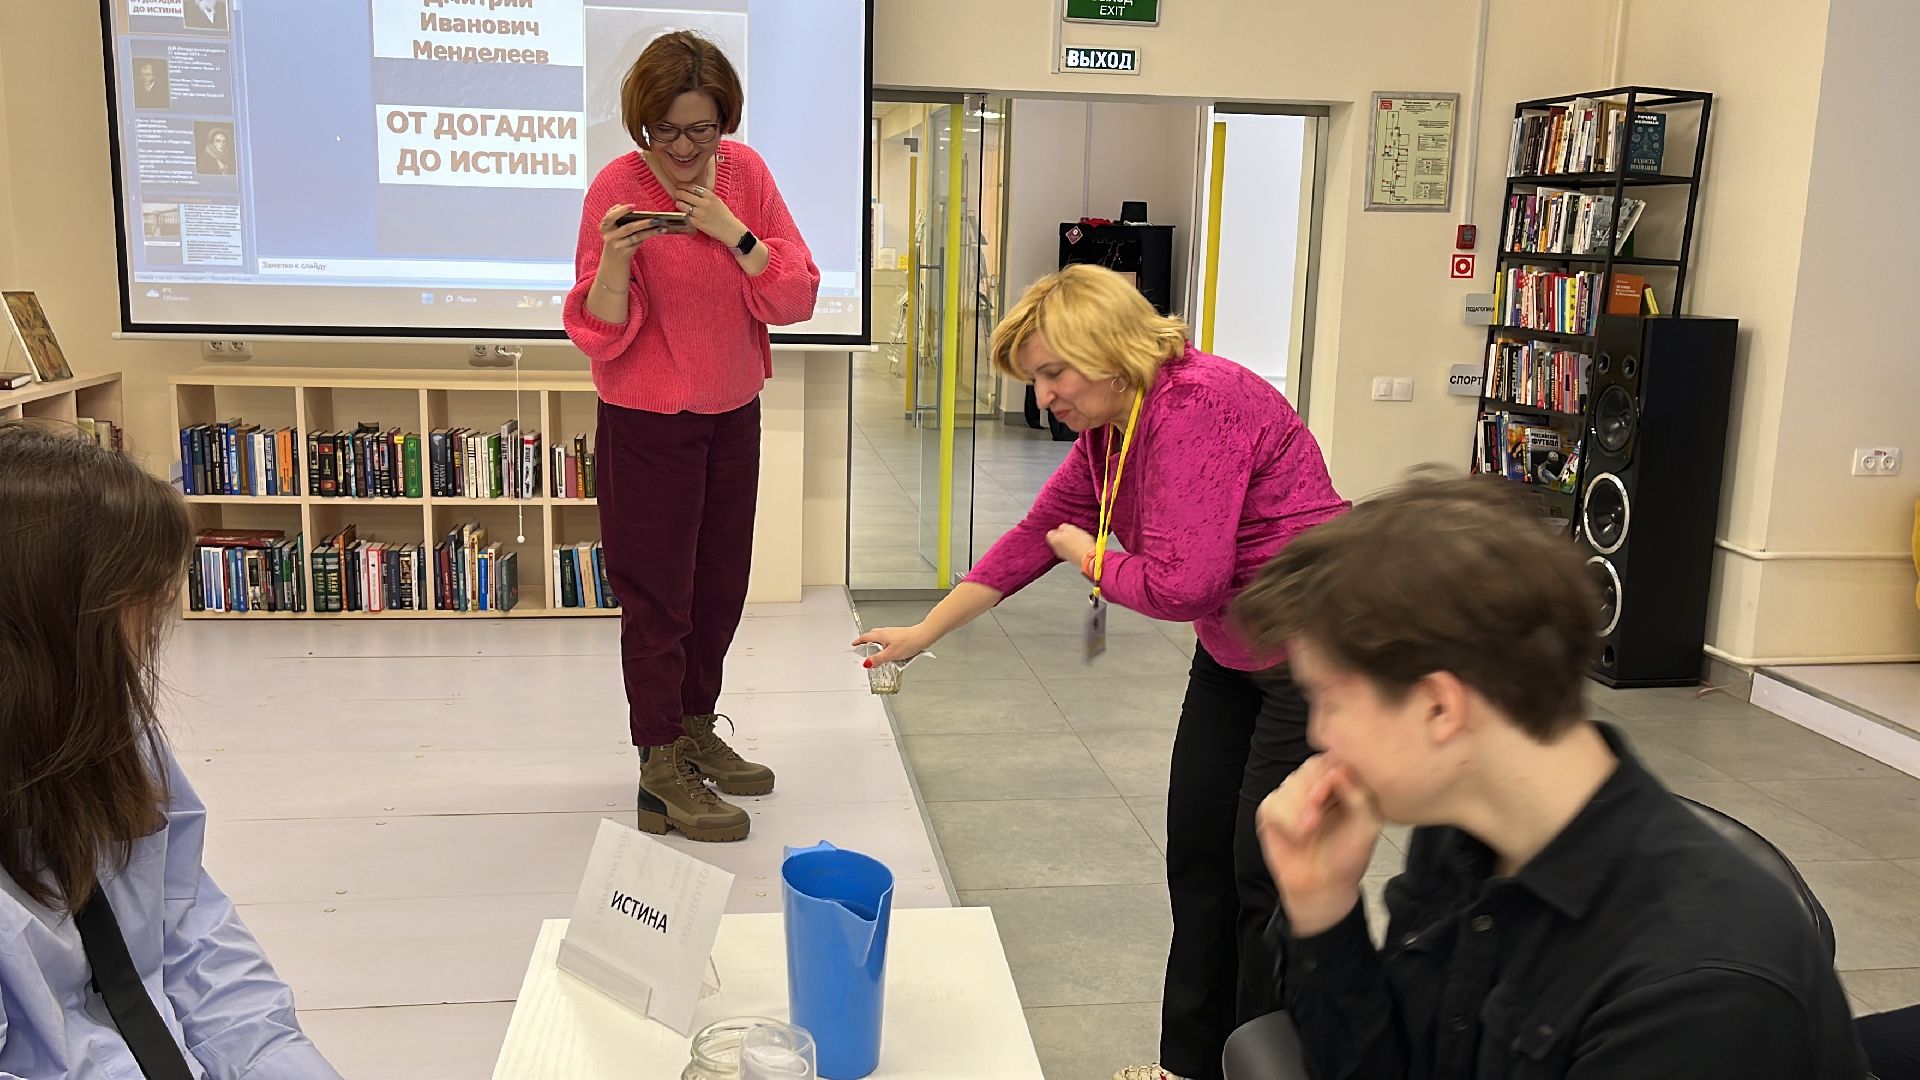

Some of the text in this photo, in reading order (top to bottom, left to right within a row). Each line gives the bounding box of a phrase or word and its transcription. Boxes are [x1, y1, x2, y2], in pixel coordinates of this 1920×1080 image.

[1100, 5, 1125, 16] EXIT
[420, 12, 539, 36] Иванович
[413, 39, 549, 64] Менделеев
[1067, 49, 1132, 70] ВЫХОД
[386, 110, 577, 142] ОТ ДОГАДКИ
[396, 148, 577, 176] ДО ИСТИНЫ
[262, 261, 294, 269] Заметки
[301, 262, 327, 272] слайду
[1450, 375, 1483, 385] СПОРТ
[610, 890, 670, 934] ИСТИНА
